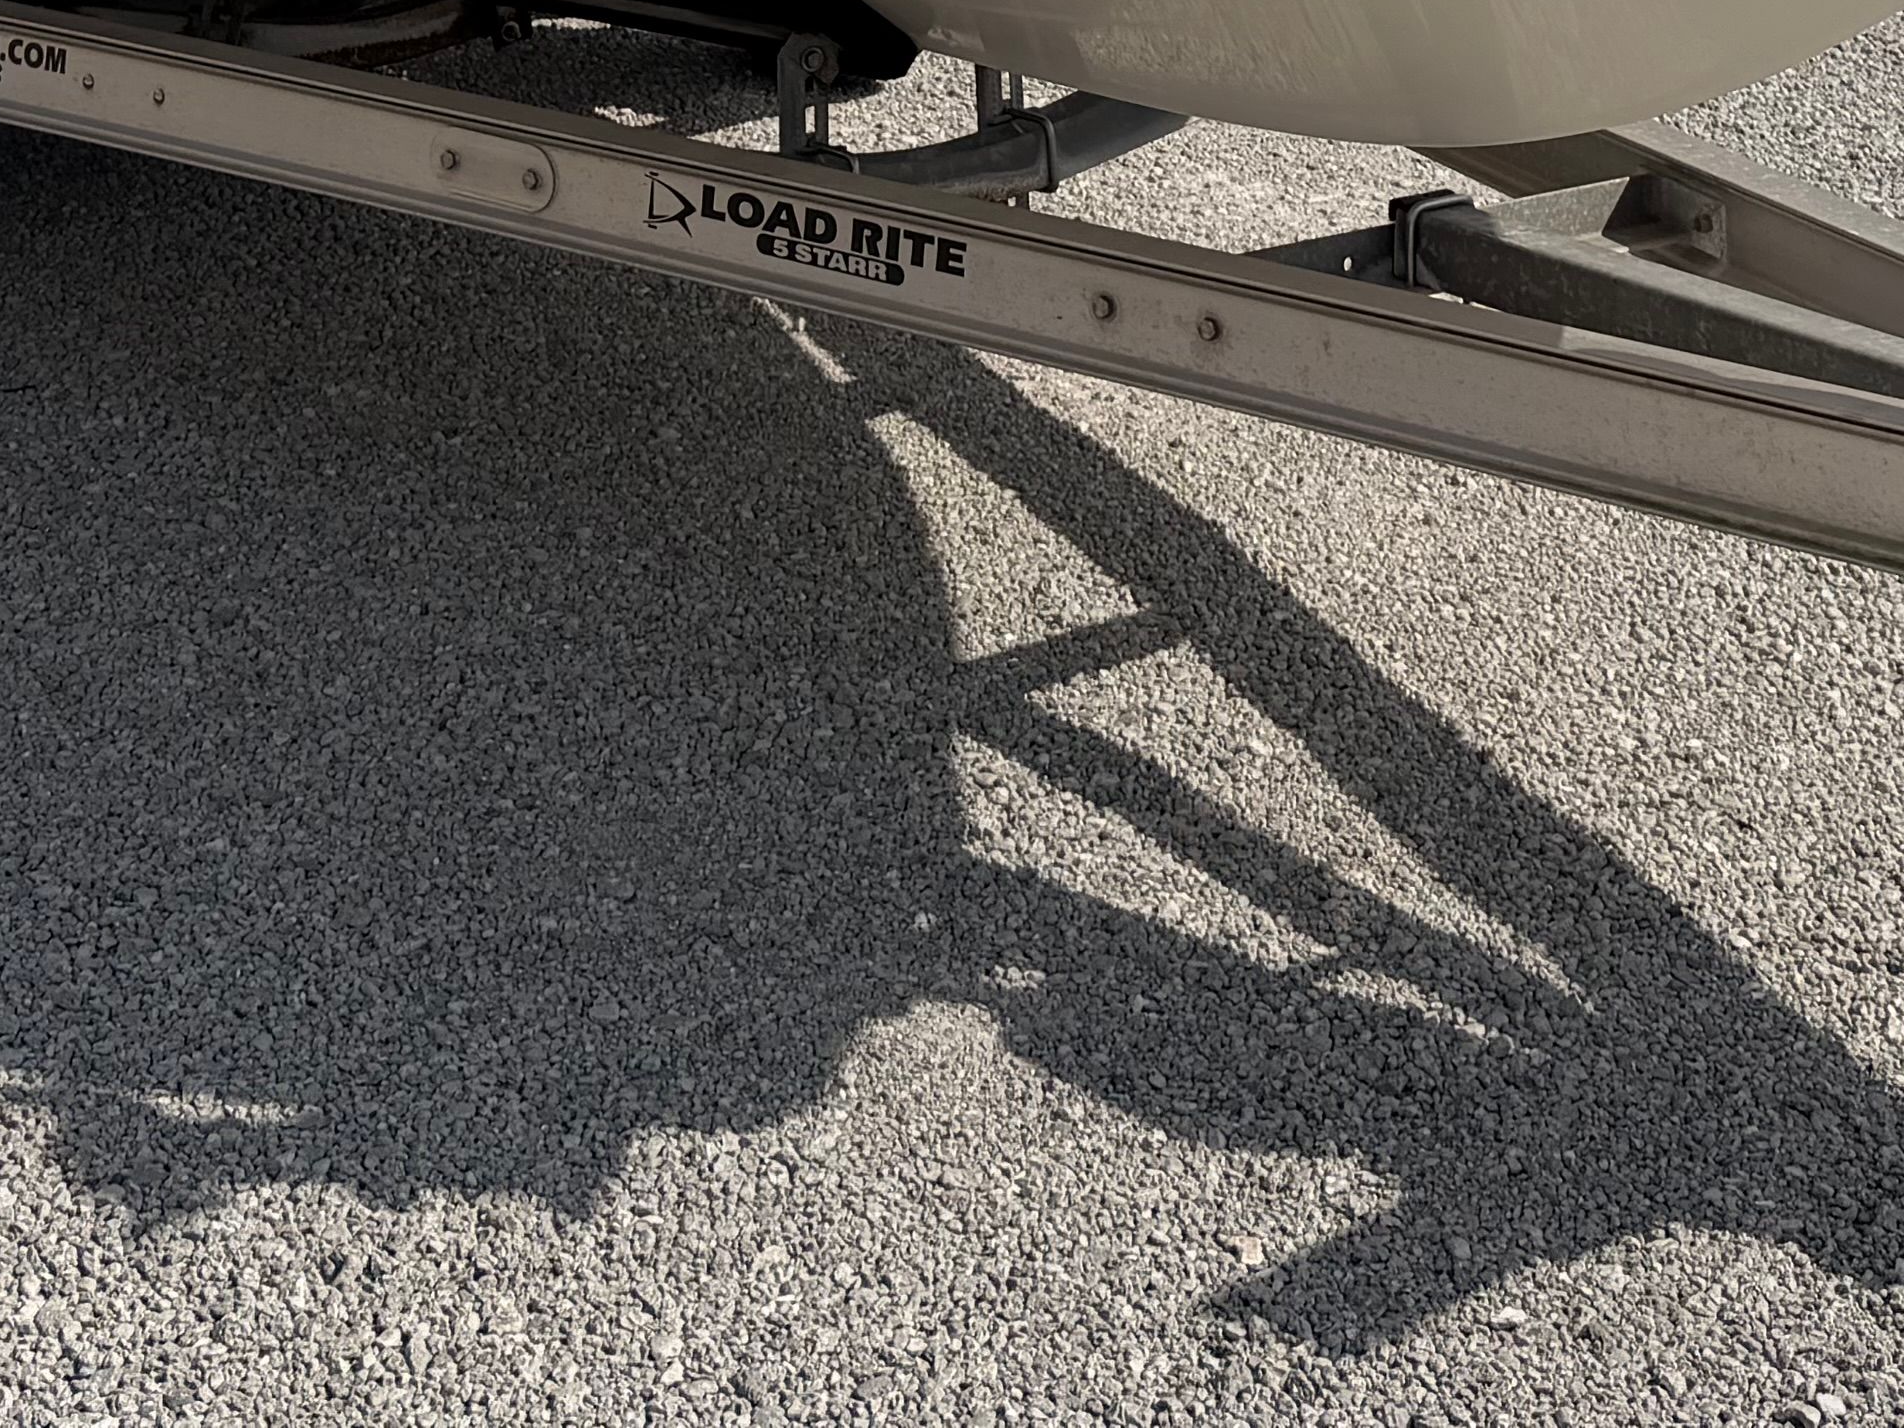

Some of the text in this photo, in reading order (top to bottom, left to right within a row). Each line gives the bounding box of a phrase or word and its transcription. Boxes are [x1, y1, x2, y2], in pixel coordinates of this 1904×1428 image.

[700, 183, 968, 277] LOAD RITE
[772, 241, 888, 282] 5 STARR
